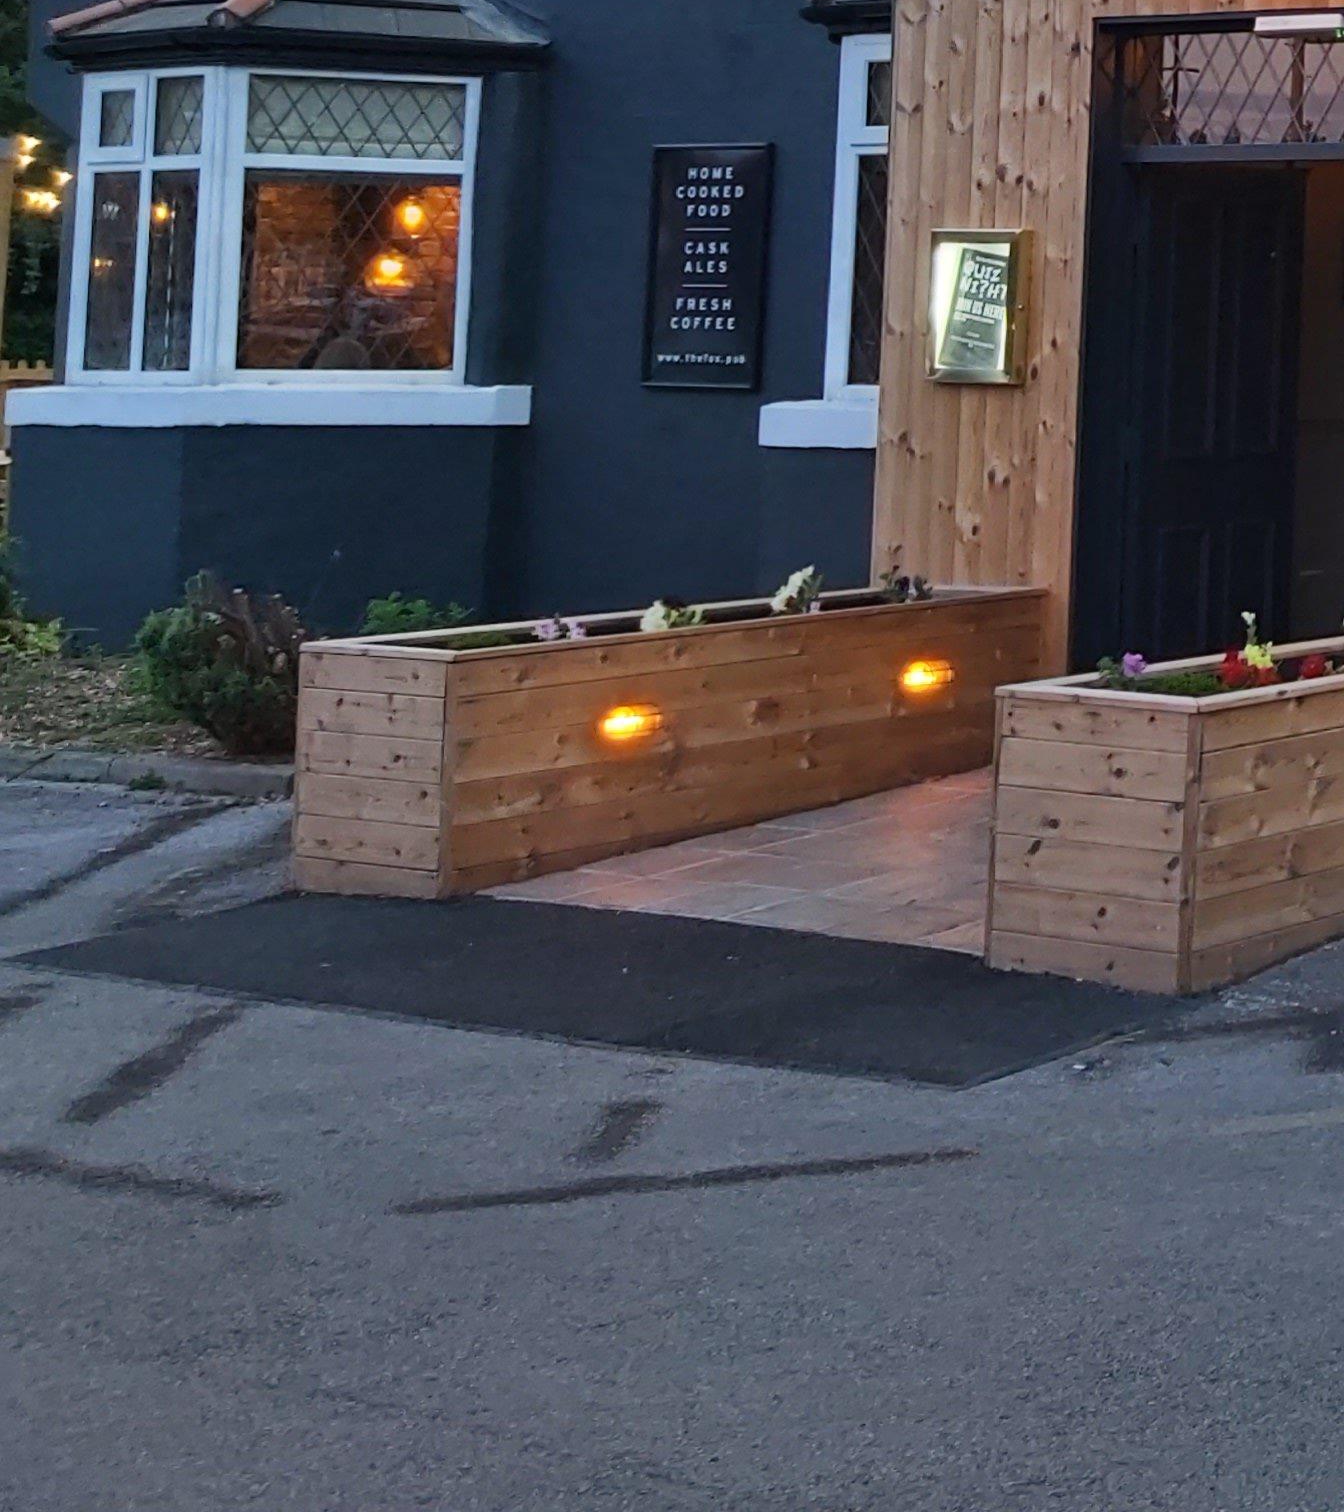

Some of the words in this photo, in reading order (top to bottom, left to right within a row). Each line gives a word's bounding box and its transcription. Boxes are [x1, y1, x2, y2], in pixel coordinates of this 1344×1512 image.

[687, 167, 734, 180] HOME
[676, 185, 744, 199] COOKED
[686, 204, 731, 217] FOOD
[684, 242, 730, 255] CASK
[684, 261, 727, 274] ALES
[963, 260, 1001, 282] QUIZ
[675, 298, 732, 311] FRESH
[670, 317, 736, 330] COFFEE
